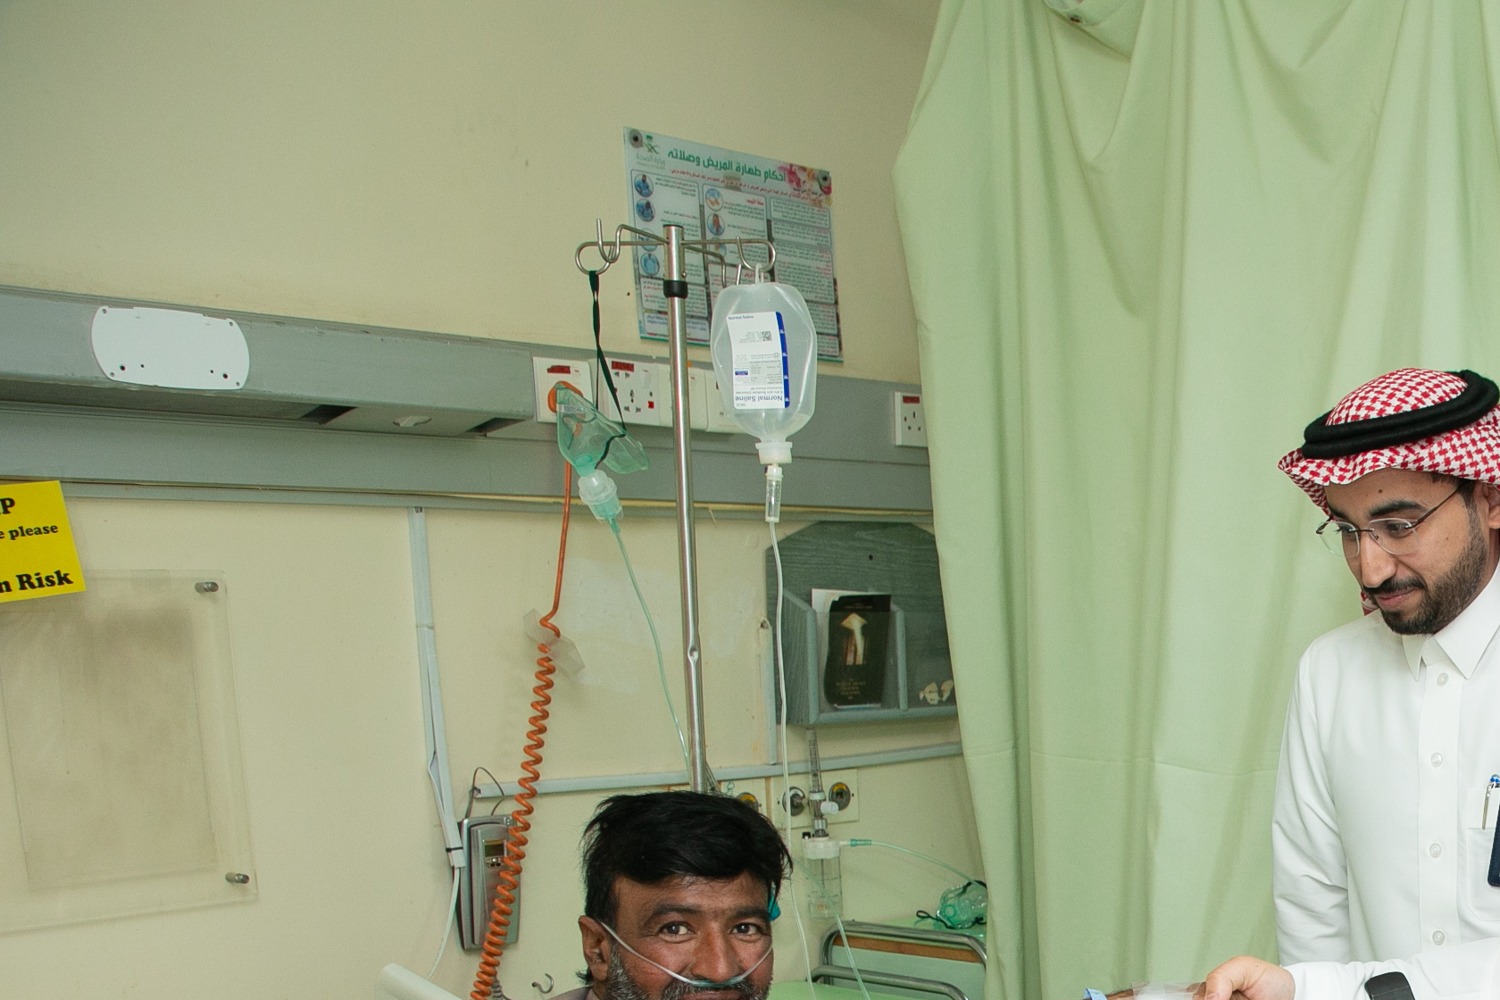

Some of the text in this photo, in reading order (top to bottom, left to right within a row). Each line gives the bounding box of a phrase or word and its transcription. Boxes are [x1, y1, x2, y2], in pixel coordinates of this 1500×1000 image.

[735, 395, 756, 403] Saline
[0, 498, 16, 515] P
[8, 525, 59, 541] please
[15, 569, 74, 591] Risk
